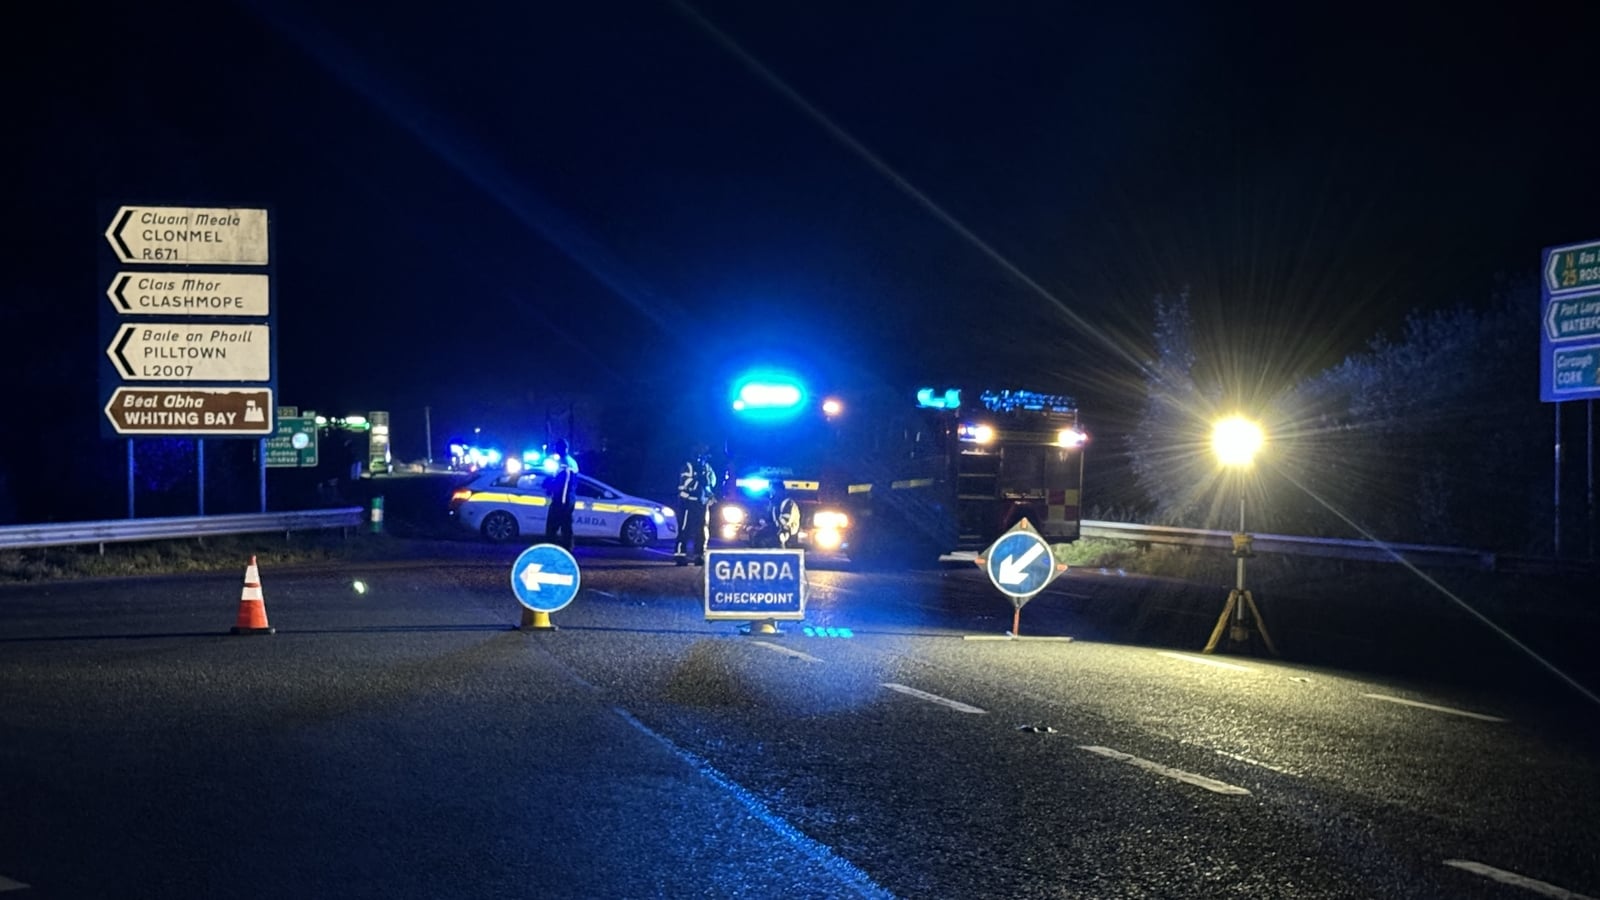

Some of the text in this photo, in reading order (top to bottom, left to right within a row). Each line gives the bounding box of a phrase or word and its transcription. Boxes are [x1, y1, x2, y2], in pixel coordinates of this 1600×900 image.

[141, 212, 241, 226] Cluain Meala
[142, 229, 223, 242] CLONMEL
[143, 248, 178, 260] R671
[138, 278, 175, 291] Clais
[142, 329, 252, 342] Baile an Phoill
[144, 346, 226, 359] PILLTOWN
[143, 365, 193, 377] L2007
[124, 412, 237, 425] WHITING BAY
[573, 516, 607, 527] ARDA
[715, 560, 794, 580] GARDA
[715, 592, 794, 604] CHECKPOINT
